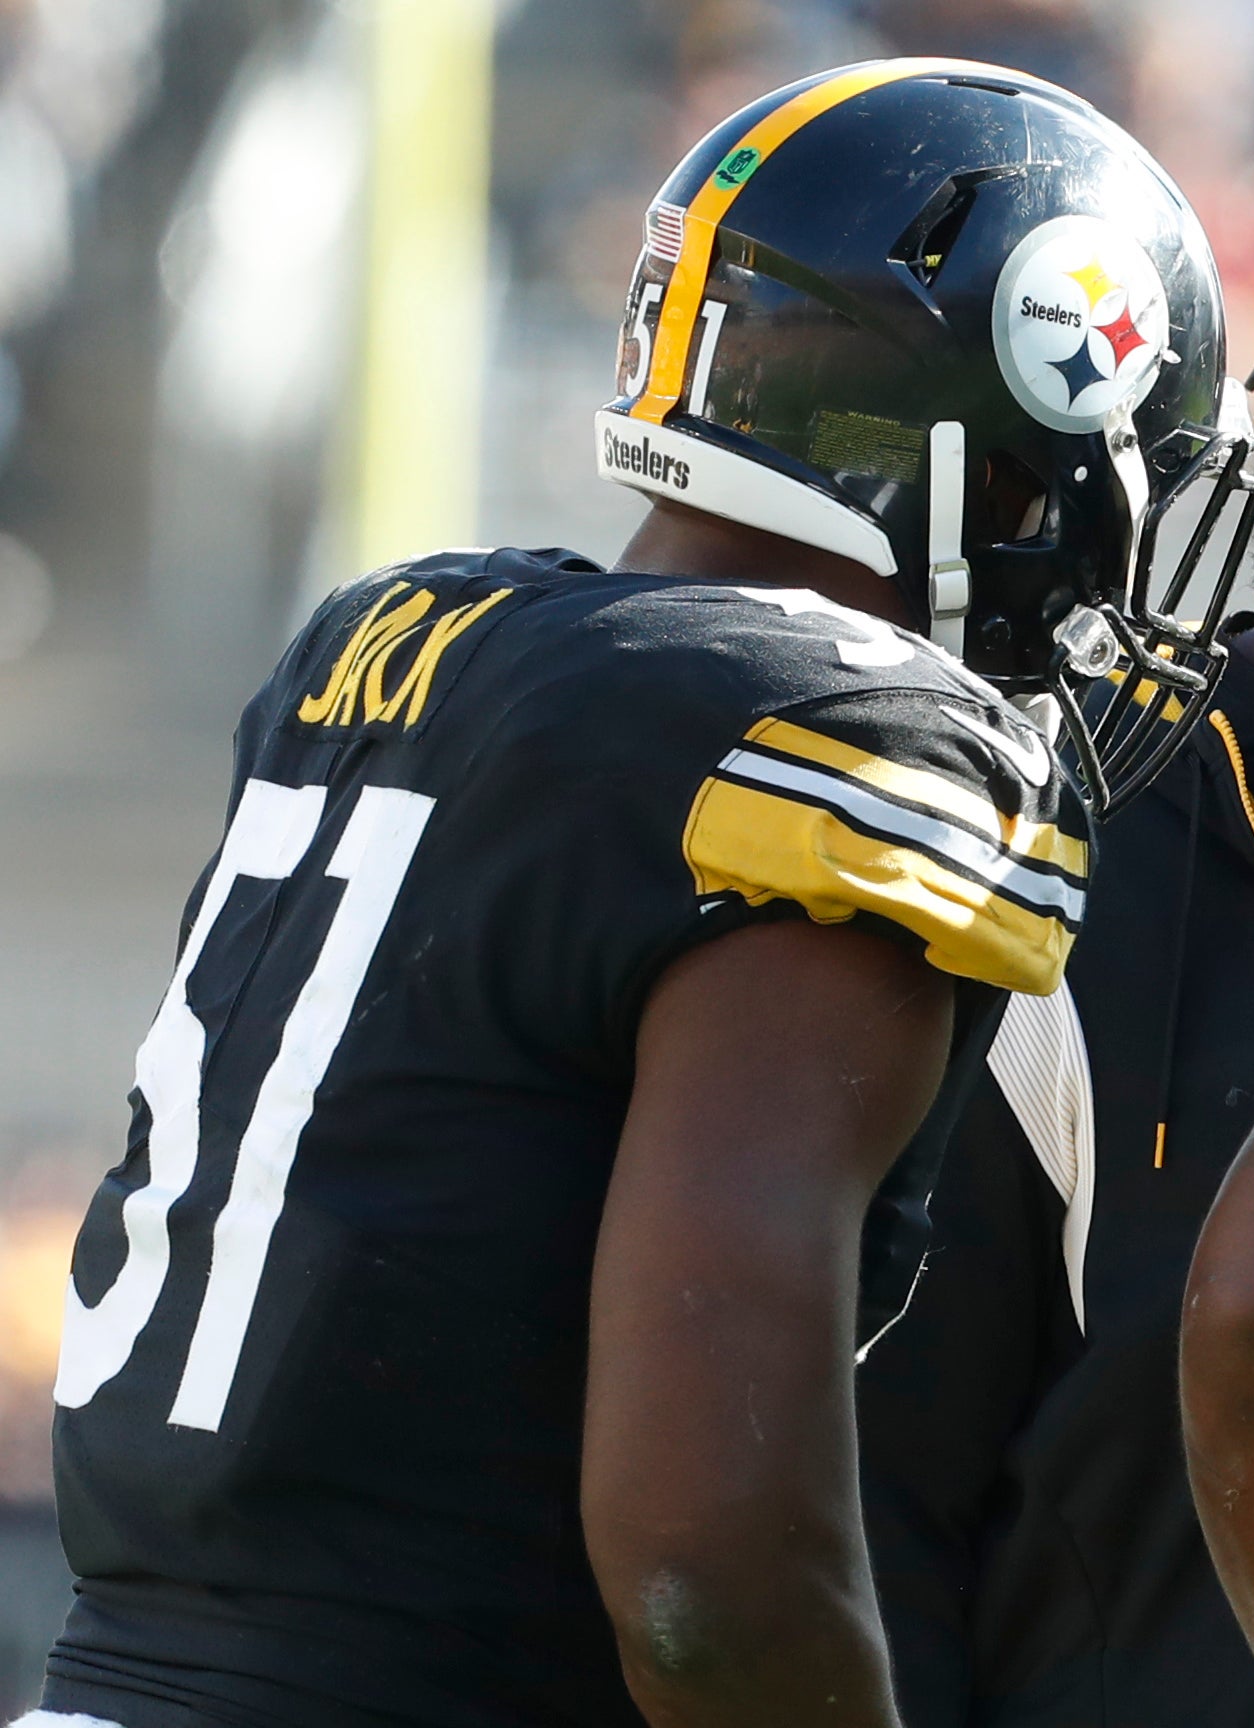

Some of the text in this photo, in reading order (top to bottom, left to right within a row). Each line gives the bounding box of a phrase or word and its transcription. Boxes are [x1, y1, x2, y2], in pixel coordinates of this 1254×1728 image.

[1020, 296, 1083, 328] Steelers
[847, 410, 901, 427] WARNING
[604, 427, 690, 490] Steelers
[298, 581, 514, 732] JACK
[53, 777, 437, 1433] 51
